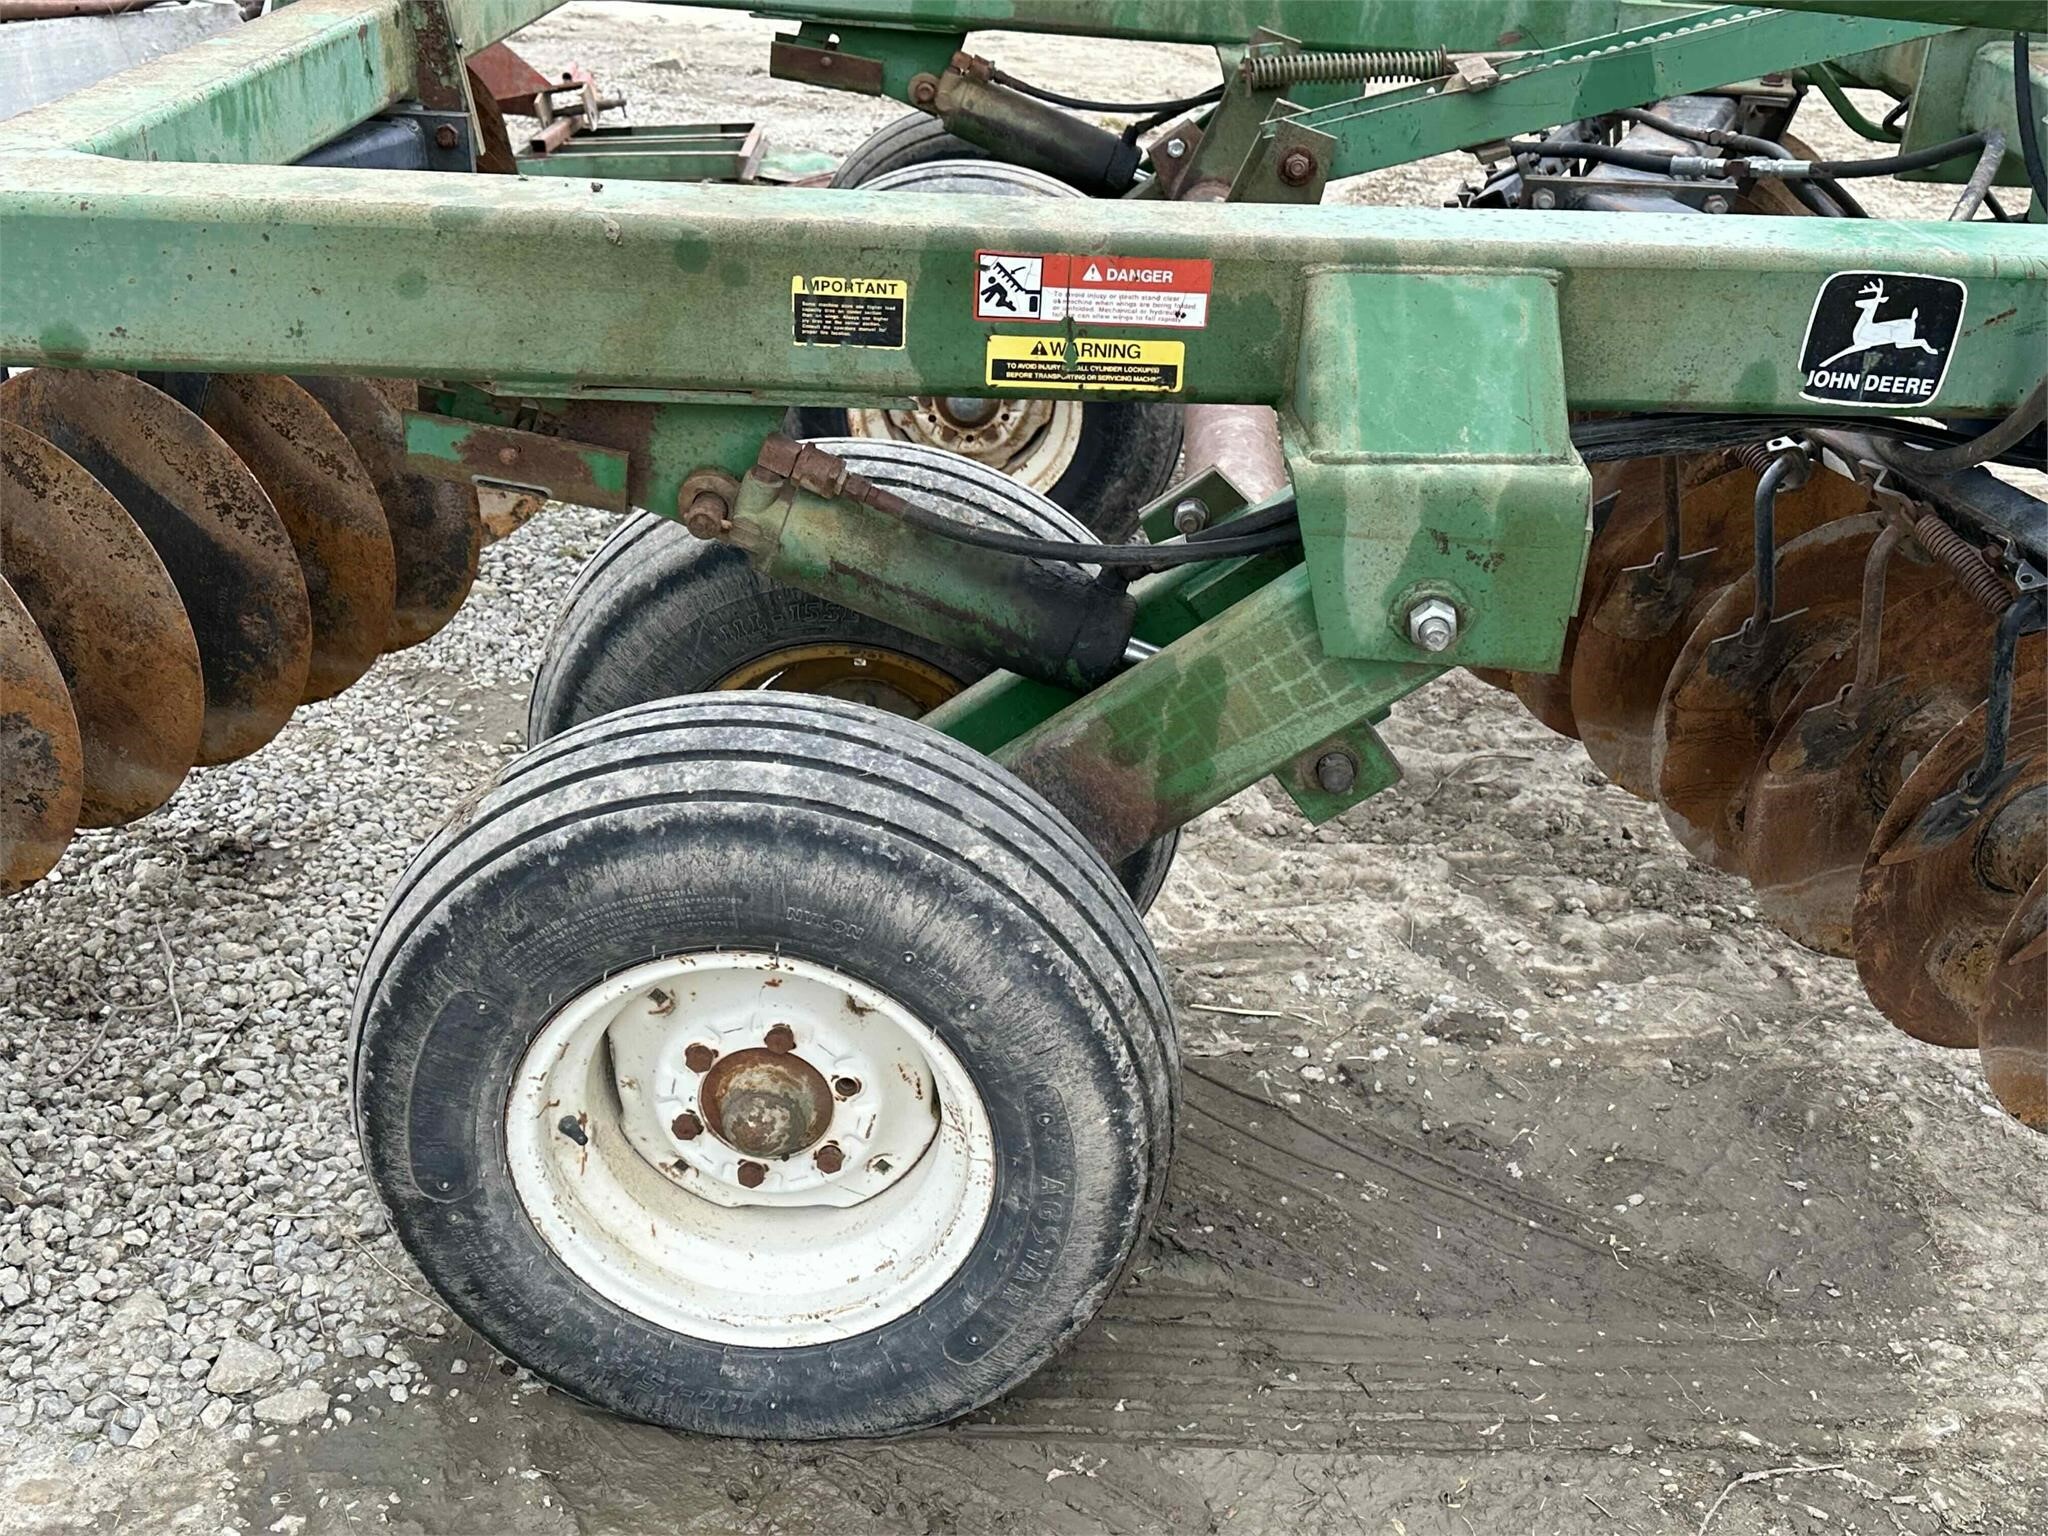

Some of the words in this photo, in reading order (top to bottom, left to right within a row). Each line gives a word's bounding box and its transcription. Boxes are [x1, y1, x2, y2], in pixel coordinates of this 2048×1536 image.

[1106, 268, 1173, 284] DANGER
[802, 280, 898, 294] IMPORTANT
[1806, 369, 1861, 390] JOHN
[1864, 375, 1935, 396] DEERE
[786, 907, 864, 941] NYLON
